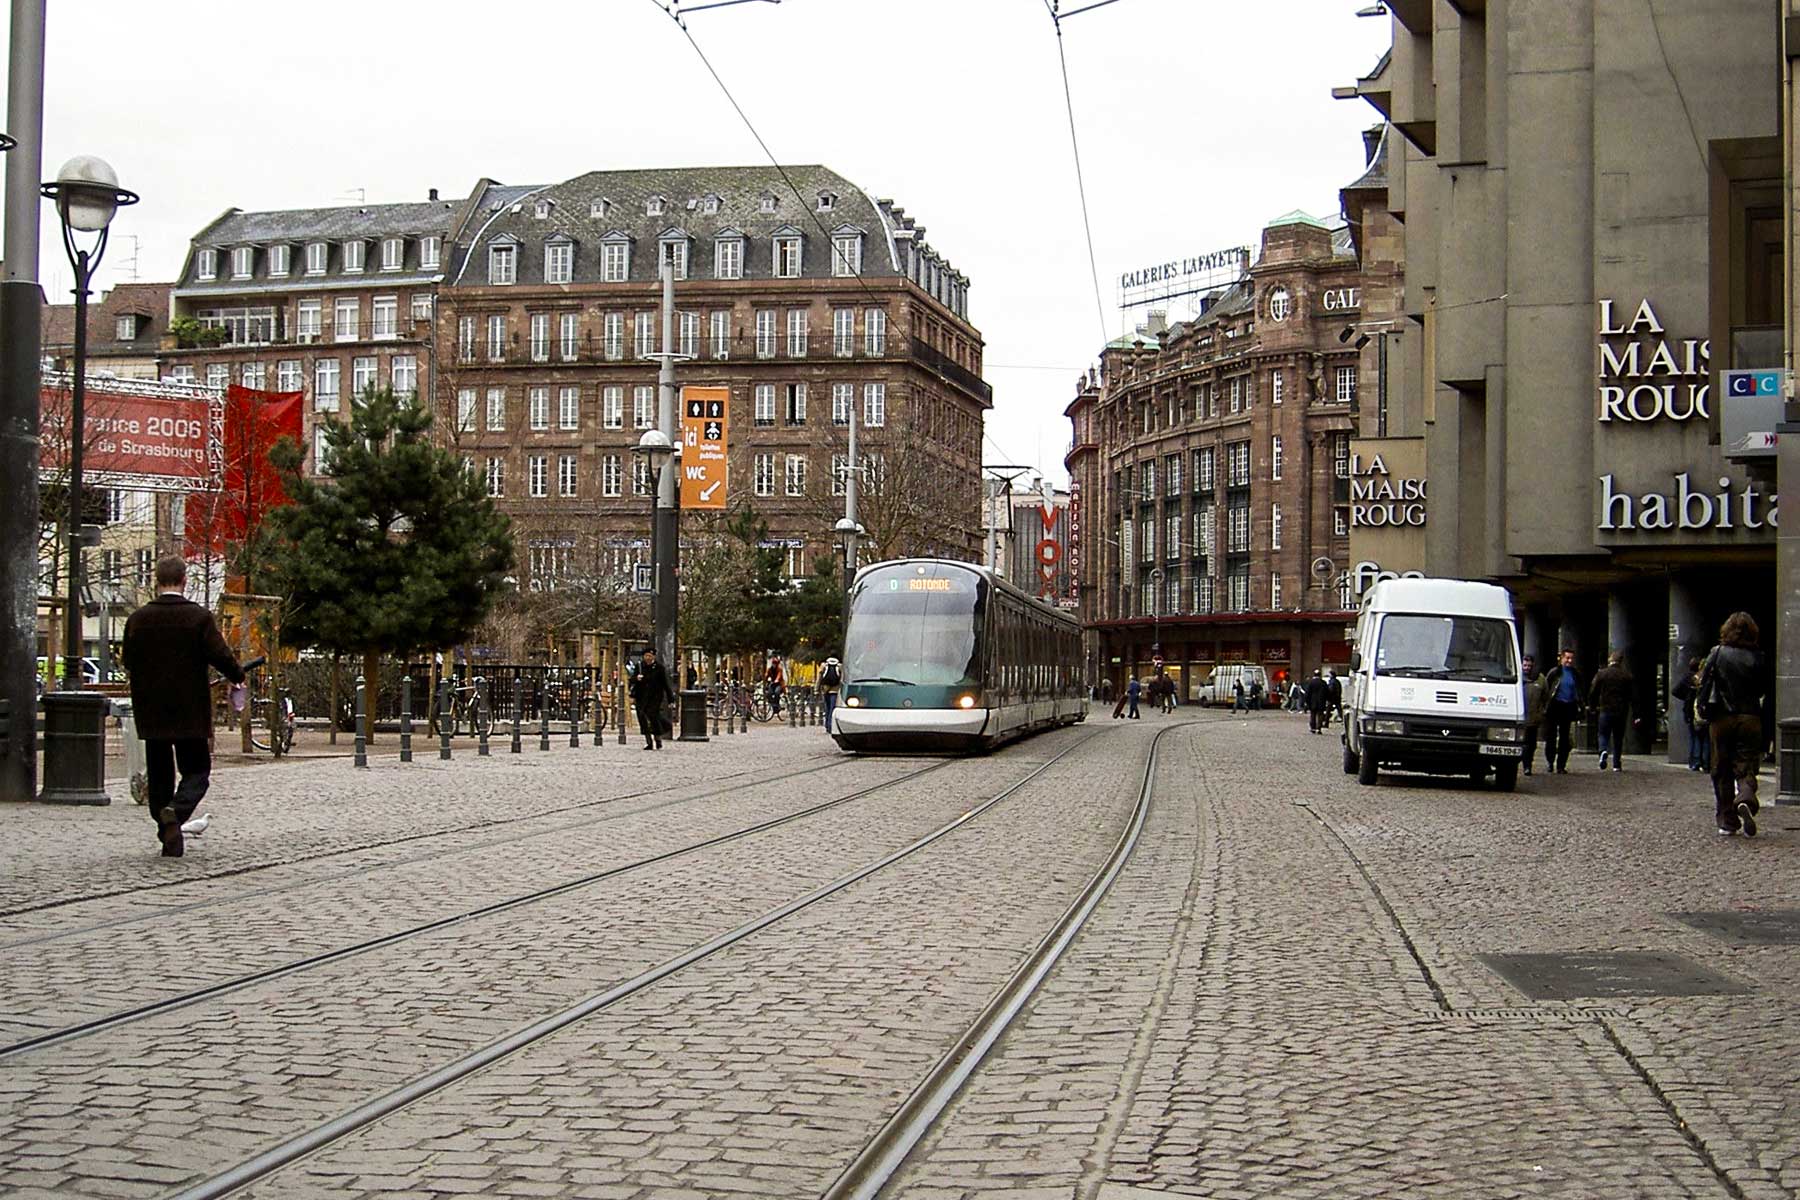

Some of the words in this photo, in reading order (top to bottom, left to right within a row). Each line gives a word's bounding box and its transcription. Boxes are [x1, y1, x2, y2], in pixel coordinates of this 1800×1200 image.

[1122, 261, 1178, 288] GALERIES
[1323, 287, 1360, 311] GAL
[1599, 298, 1664, 334] LA
[1733, 377, 1774, 393] CIC
[147, 416, 201, 439] 2006
[685, 426, 698, 447] ici
[98, 438, 117, 453] de
[121, 439, 204, 463] Strasbourg
[686, 466, 706, 480] WC
[1352, 454, 1389, 475] LA
[1352, 503, 1426, 526] ROUG
[1036, 505, 1063, 598] VOX
[910, 579, 950, 591] ROTONDE
